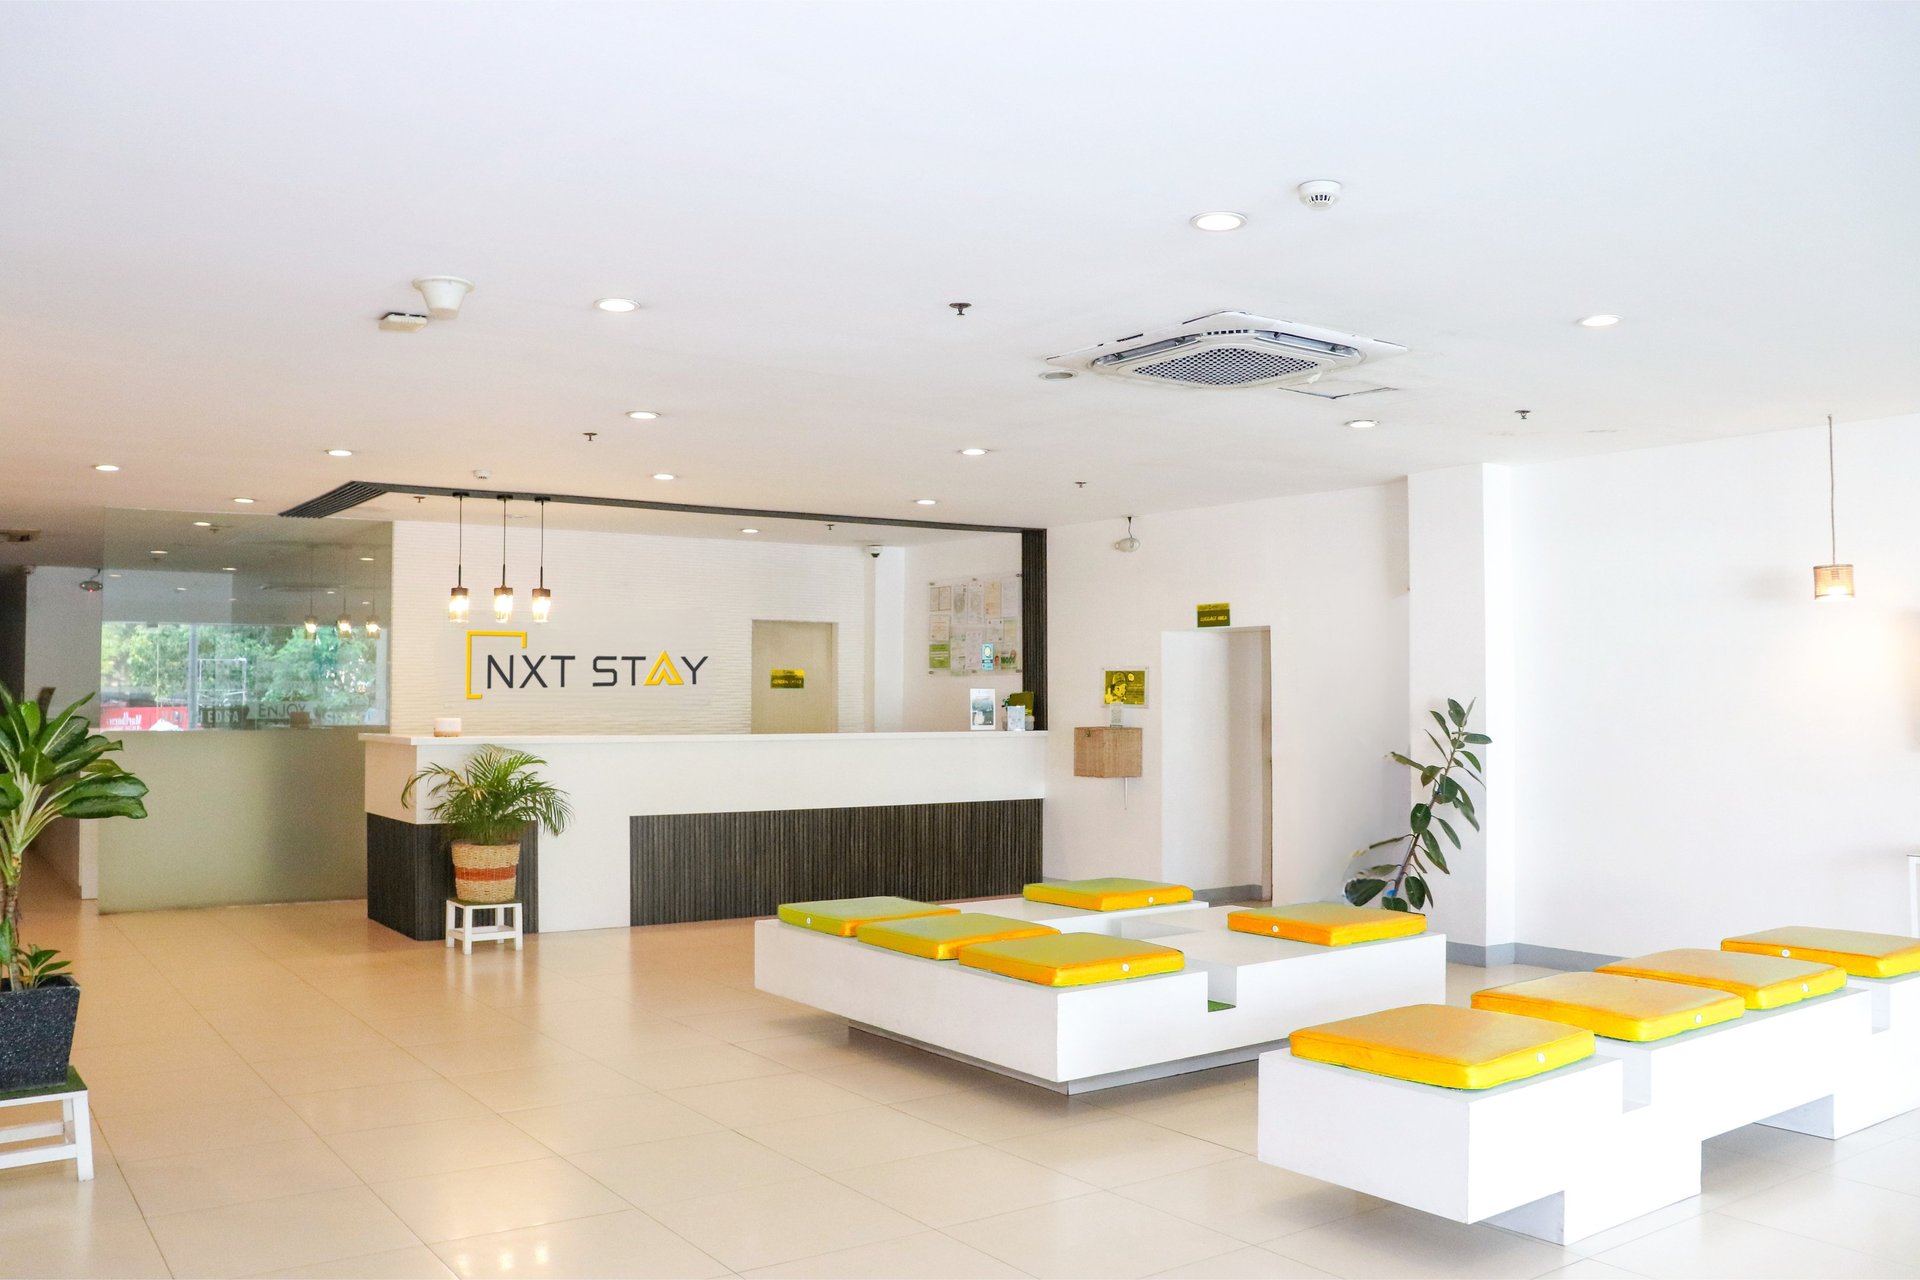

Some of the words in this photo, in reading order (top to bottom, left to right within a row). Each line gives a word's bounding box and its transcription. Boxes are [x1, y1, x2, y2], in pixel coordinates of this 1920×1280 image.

[487, 655, 575, 689] NXT
[592, 650, 709, 687] STAY
[207, 710, 239, 724] EDSA
[259, 703, 306, 718] ENJOY
